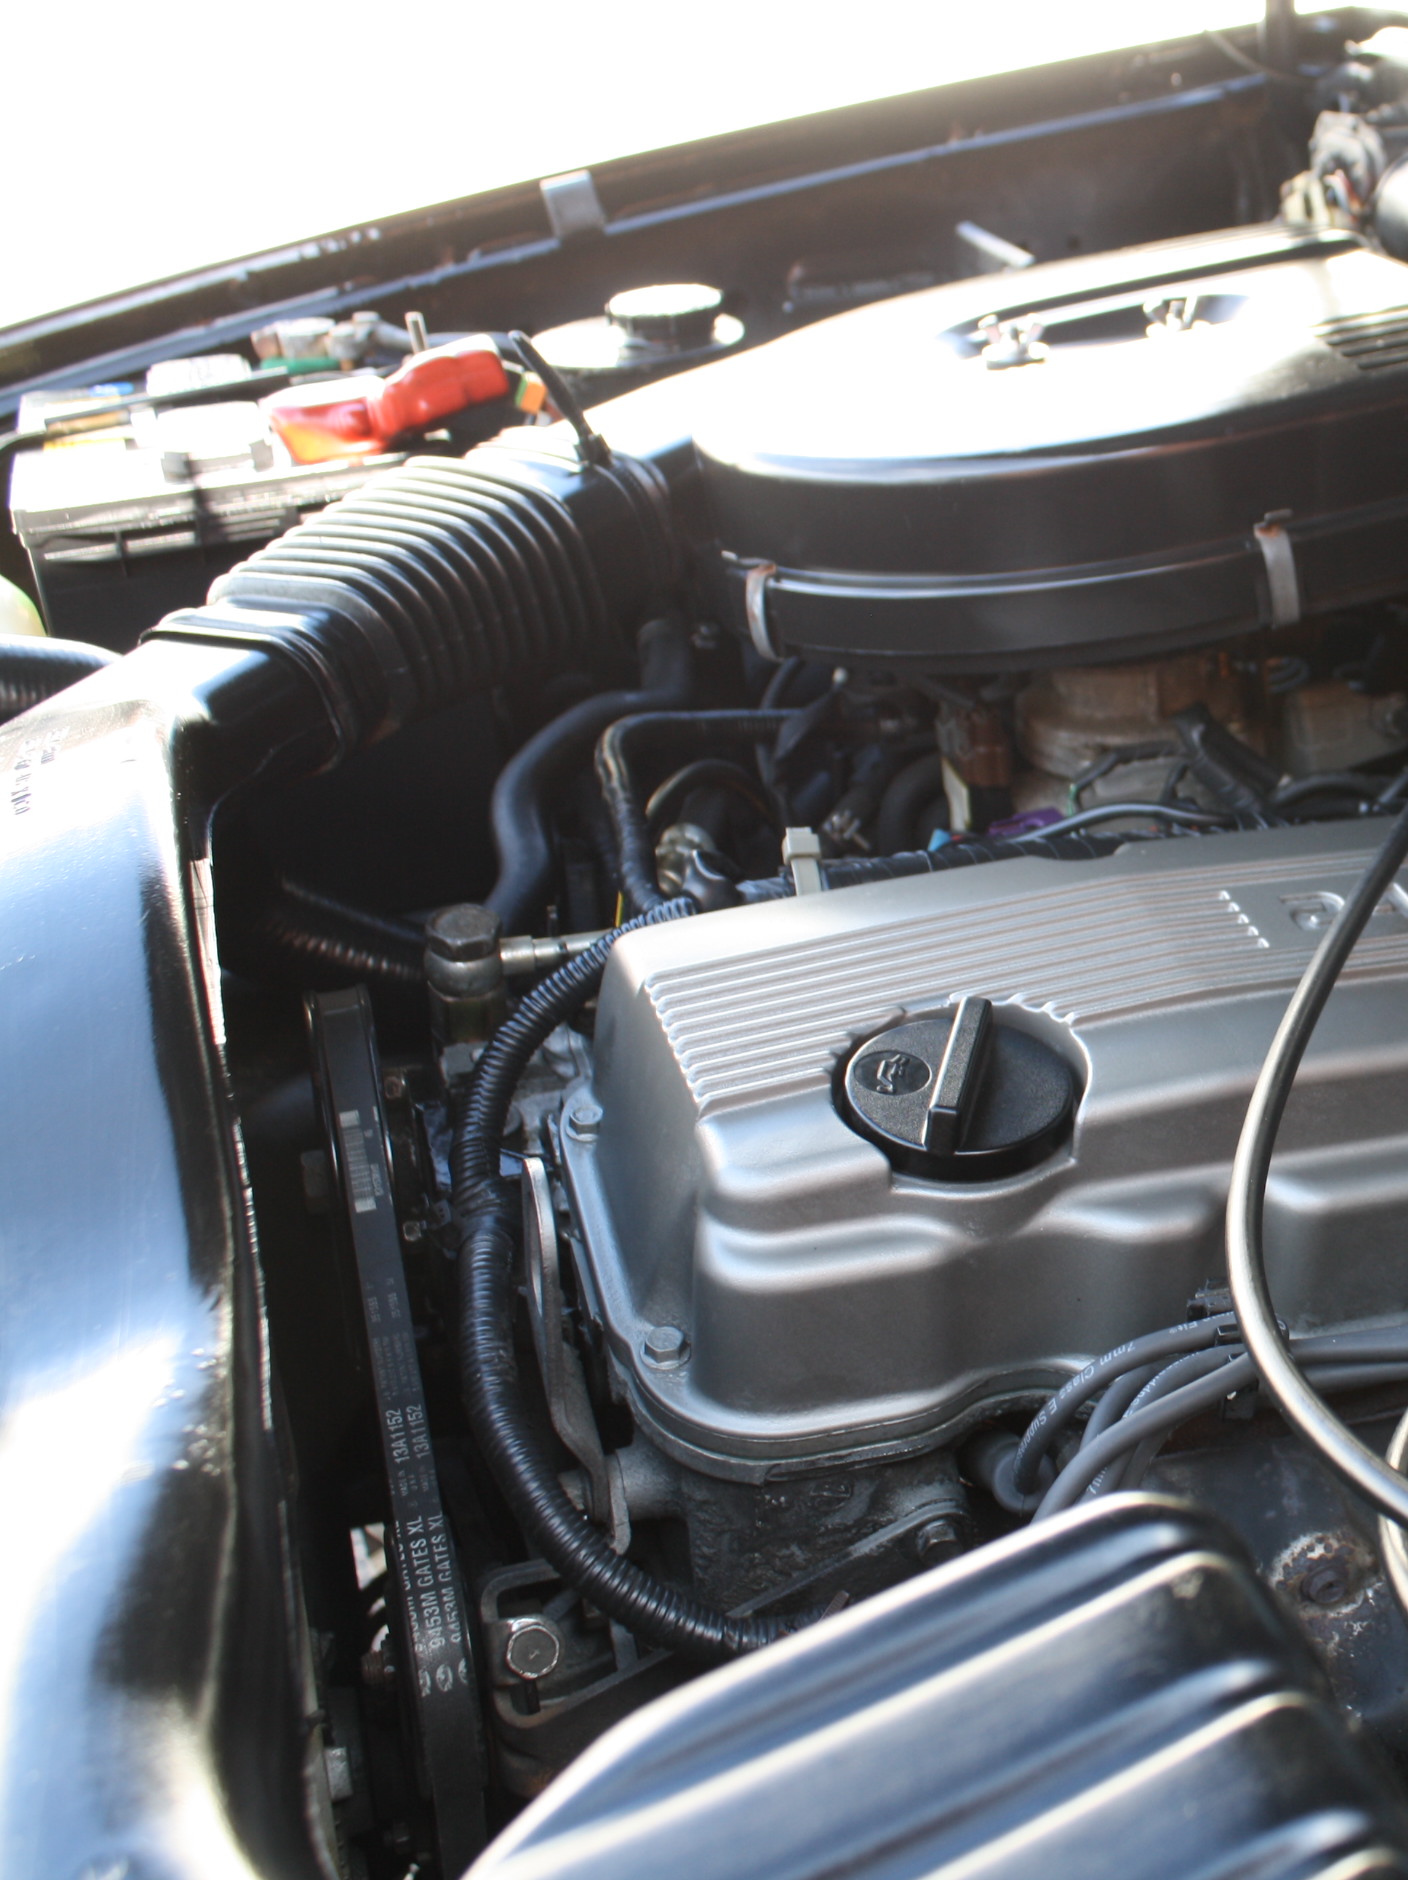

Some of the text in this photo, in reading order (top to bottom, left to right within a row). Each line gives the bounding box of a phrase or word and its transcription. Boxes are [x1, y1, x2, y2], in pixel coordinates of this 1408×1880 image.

[1100, 1341, 1136, 1366] 7mm
[1059, 1364, 1095, 1400] Class
[1047, 1399, 1059, 1416] E
[385, 1408, 410, 1463] 13A1152
[406, 1404, 430, 1459] 13A1152
[406, 1515, 424, 1535] XL
[427, 1511, 444, 1531] XL
[410, 1538, 434, 1587] GATES
[420, 1591, 446, 1649] 9453M
